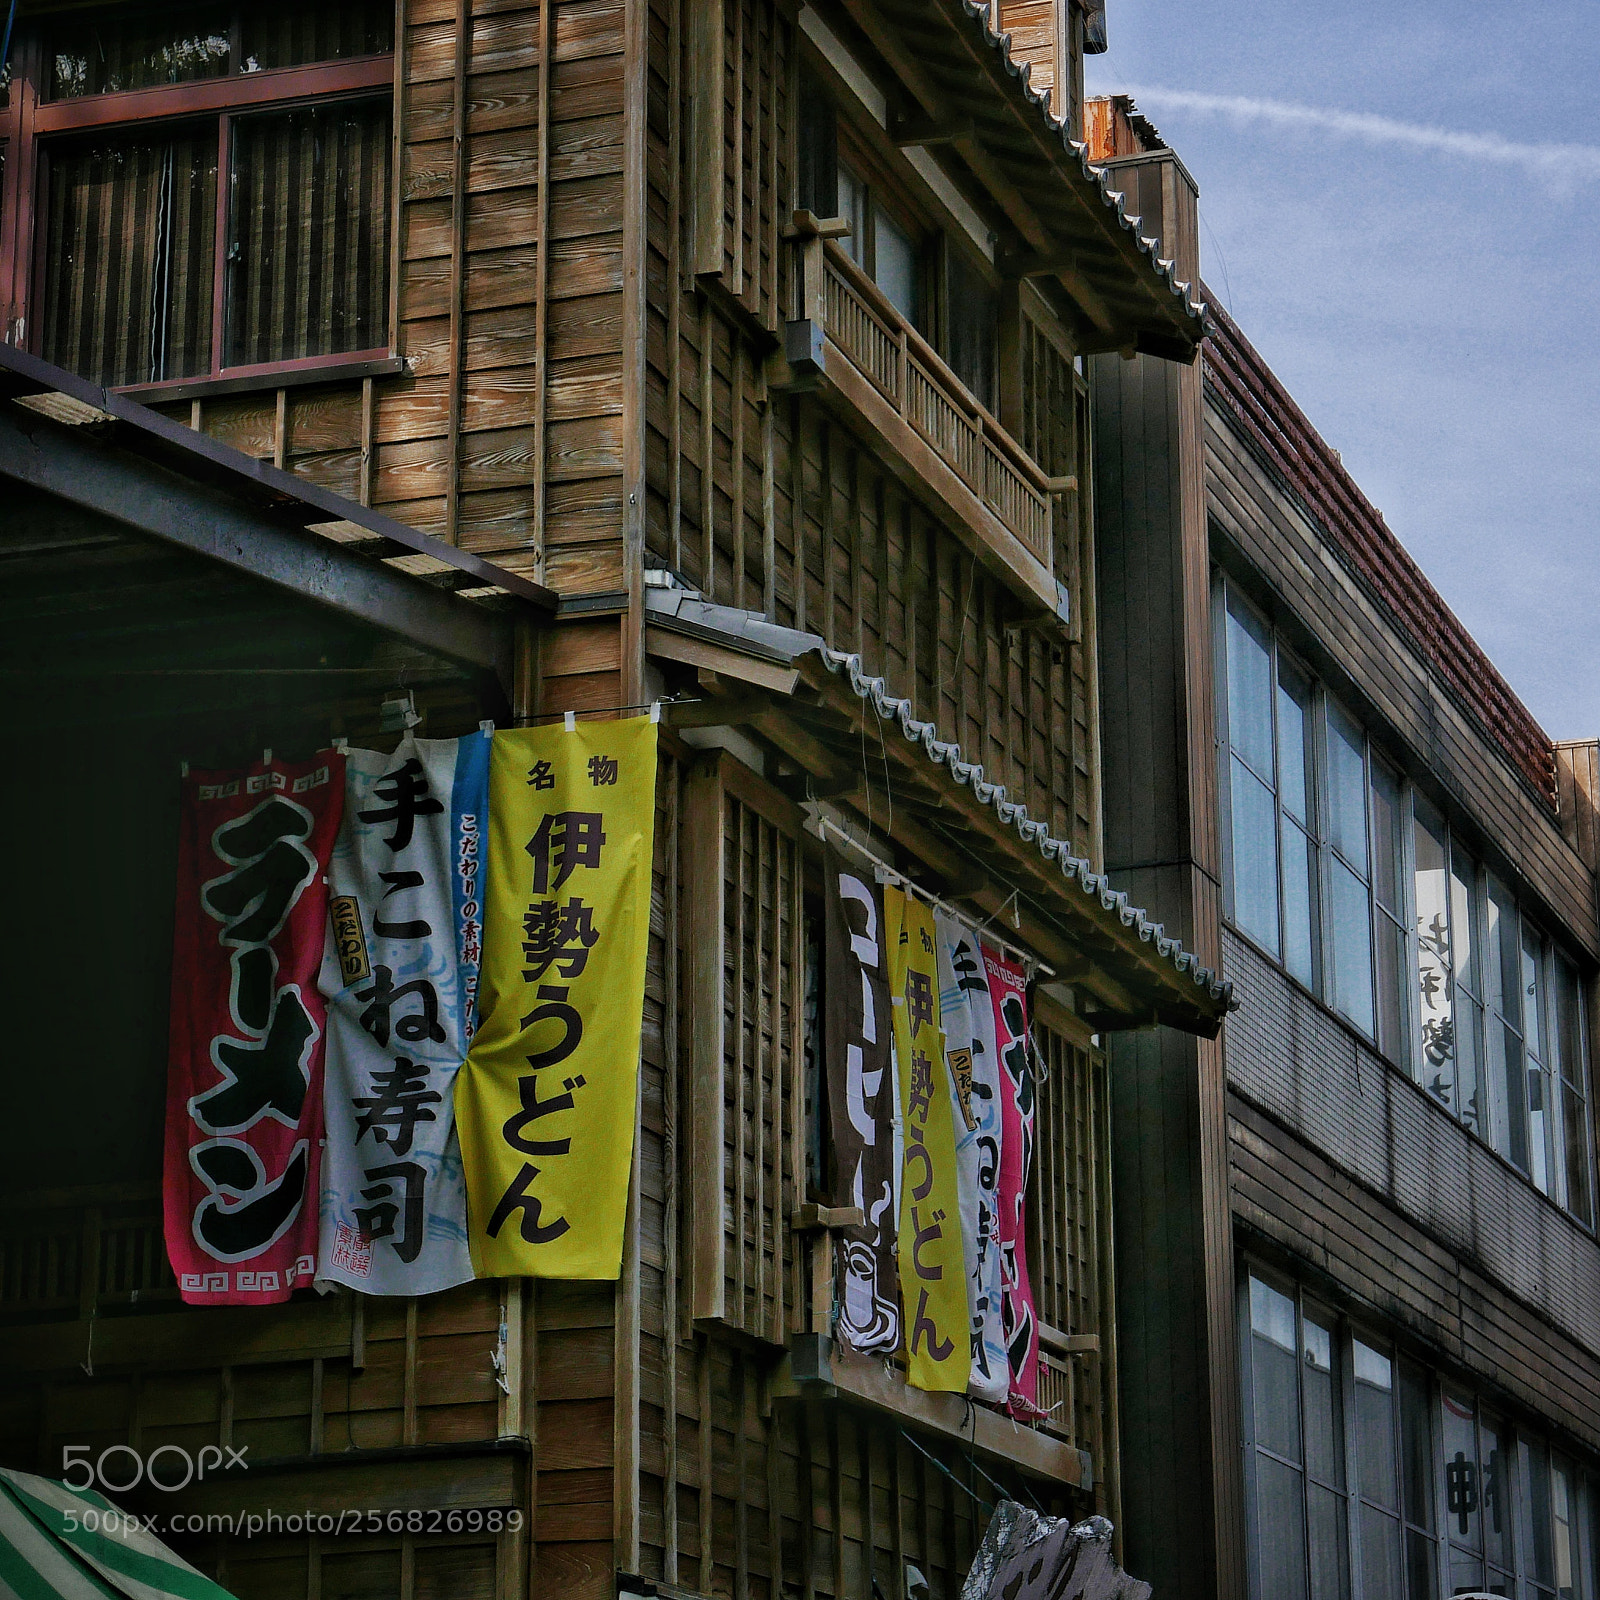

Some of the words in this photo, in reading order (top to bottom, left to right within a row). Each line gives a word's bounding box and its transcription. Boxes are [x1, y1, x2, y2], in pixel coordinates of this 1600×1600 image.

[334, 902, 362, 974] こだわり
[527, 755, 618, 791] 名物
[188, 795, 319, 1263] ラーメン
[351, 757, 446, 1265] 手こね寿司
[486, 811, 606, 1244] 伊勢うどん
